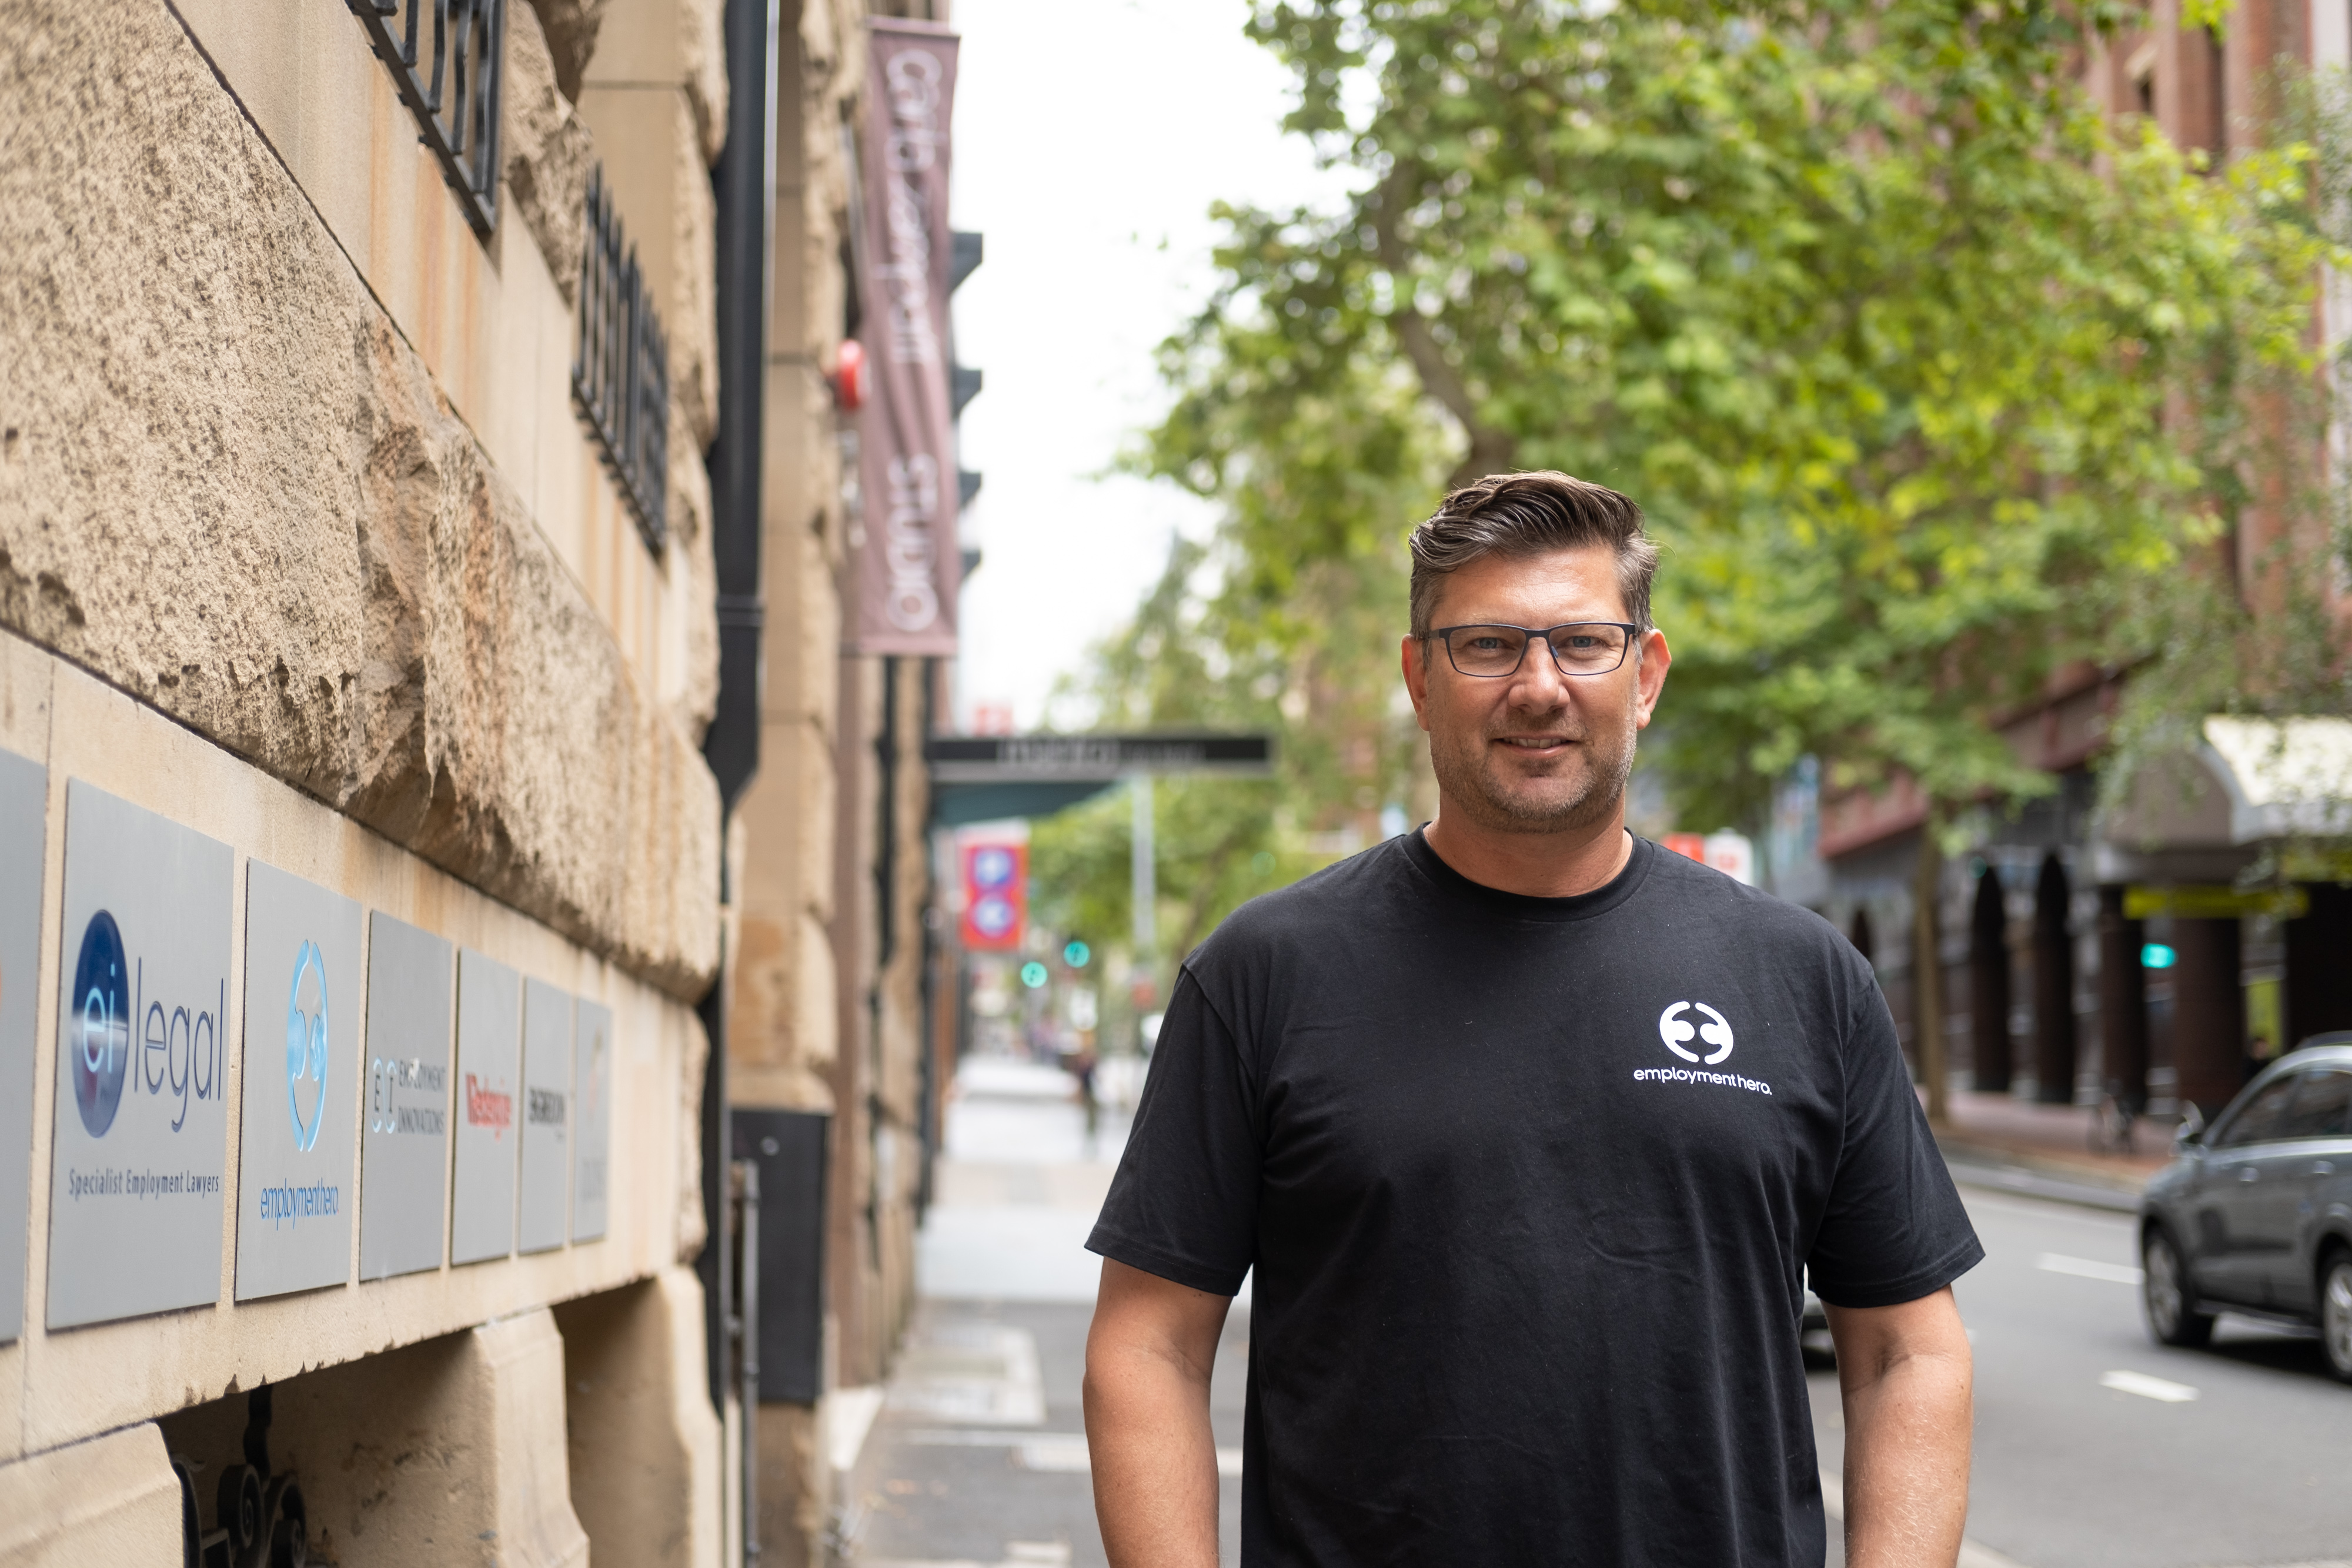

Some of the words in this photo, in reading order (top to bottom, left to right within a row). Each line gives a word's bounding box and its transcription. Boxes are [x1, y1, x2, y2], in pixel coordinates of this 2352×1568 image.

[886, 452, 944, 632] STUDIO
[135, 956, 224, 1133] legal
[397, 1105, 445, 1135] INNOVATIONS
[68, 1168, 122, 1202] Specialist
[126, 1168, 183, 1200] Employment
[186, 1169, 219, 1199] Lawyers
